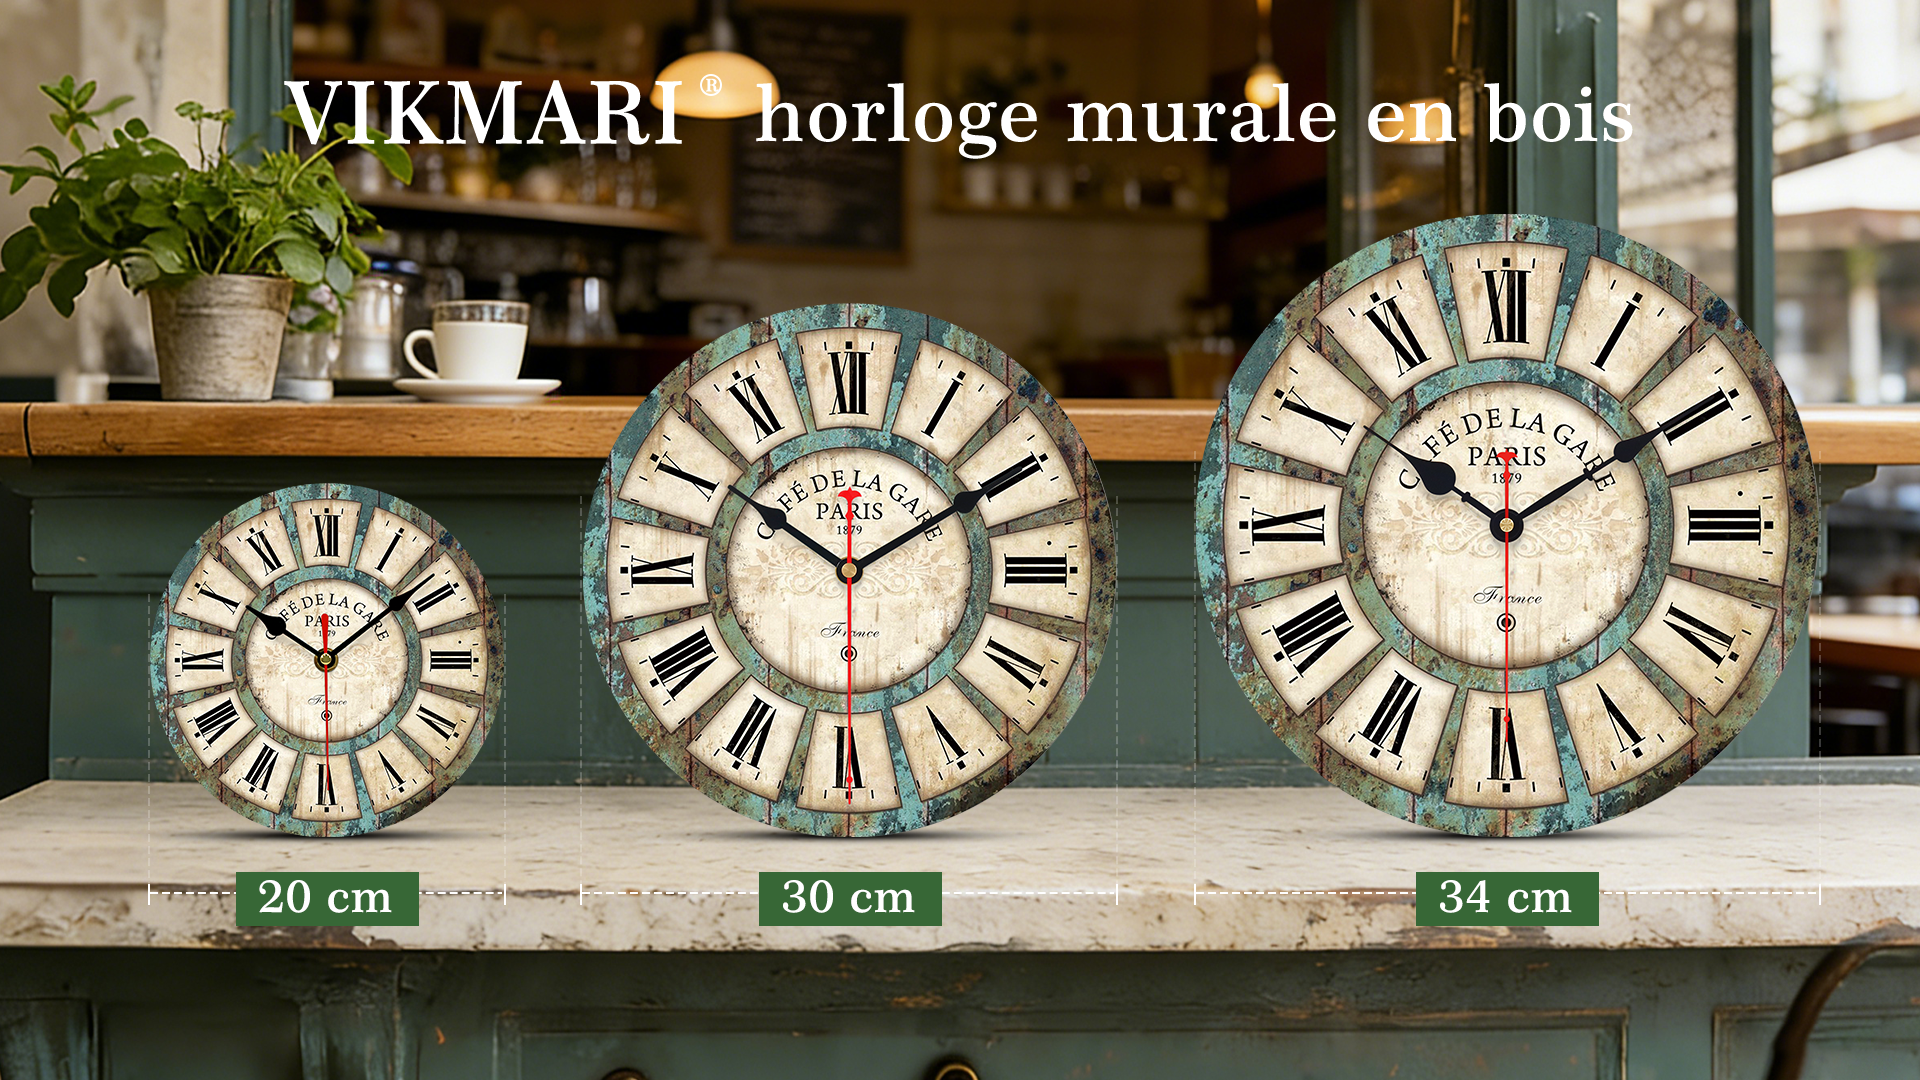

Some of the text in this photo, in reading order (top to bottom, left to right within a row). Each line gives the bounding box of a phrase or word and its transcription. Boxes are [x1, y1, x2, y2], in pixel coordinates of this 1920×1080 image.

[1399, 408, 1616, 492] CFÉ DE LA GARE
[1468, 447, 1546, 466] PARIS
[757, 470, 943, 541] CFÉ DE LA GARE
[816, 503, 883, 520] PARIS
[266, 601, 300, 640] CFÉ
[301, 594, 325, 609] DE
[330, 593, 349, 608] LA
